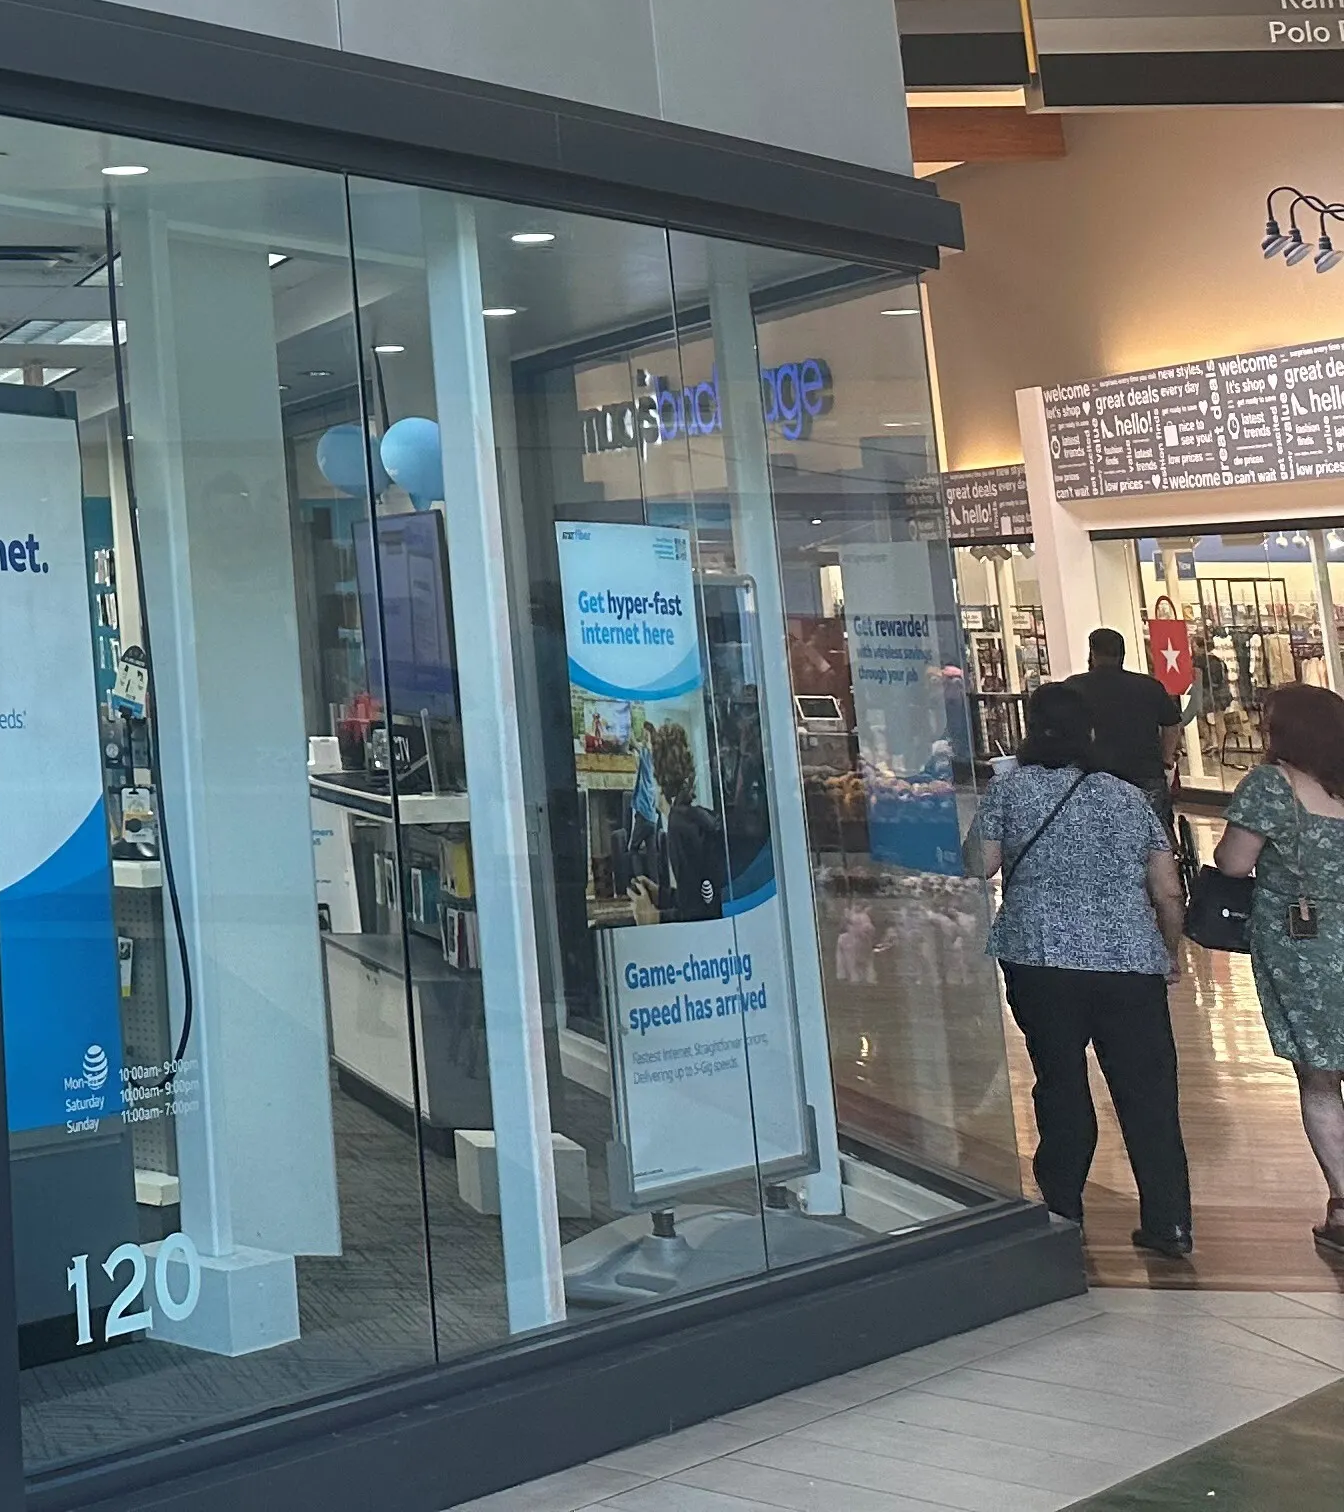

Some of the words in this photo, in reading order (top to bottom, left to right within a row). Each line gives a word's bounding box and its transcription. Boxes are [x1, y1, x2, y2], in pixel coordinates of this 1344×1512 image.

[1269, 20, 1331, 43] Polo
[1158, 369, 1174, 380] new
[1218, 354, 1278, 376] welcome
[1284, 360, 1324, 389] great
[1043, 384, 1090, 403] welcome
[1160, 386, 1183, 397] every
[1184, 381, 1200, 395] day
[1205, 360, 1222, 420] deals
[1242, 378, 1266, 394] shop
[1062, 404, 1081, 418] shop
[1095, 390, 1126, 415] great
[1127, 385, 1160, 406] deals
[1114, 411, 1153, 437] hello!
[1179, 419, 1195, 432] nice
[1196, 419, 1205, 430] to
[1243, 424, 1271, 438] trends
[1181, 436, 1194, 446] see
[1169, 471, 1221, 489] welcome
[1296, 463, 1313, 476] low
[946, 483, 971, 504] great
[972, 480, 998, 498] deals
[1119, 478, 1143, 493] prices
[962, 503, 992, 525] hello!
[578, 590, 605, 614] Get
[607, 589, 683, 620] hyper-fast
[580, 620, 640, 645] internet
[642, 620, 675, 646] here
[853, 615, 874, 637] Get
[875, 614, 930, 638] rewarded
[624, 947, 753, 990] Game-changing
[629, 996, 681, 1036] speed
[684, 993, 713, 1022] has
[716, 981, 767, 1018] arrived
[163, 1058, 200, 1076] 9:00pm
[65, 1094, 105, 1113] Saturday
[165, 1079, 200, 1096] 9:00pm
[66, 1116, 100, 1134] Sunday
[165, 1100, 200, 1117] 7:00pm
[67, 1231, 201, 1346] 120
